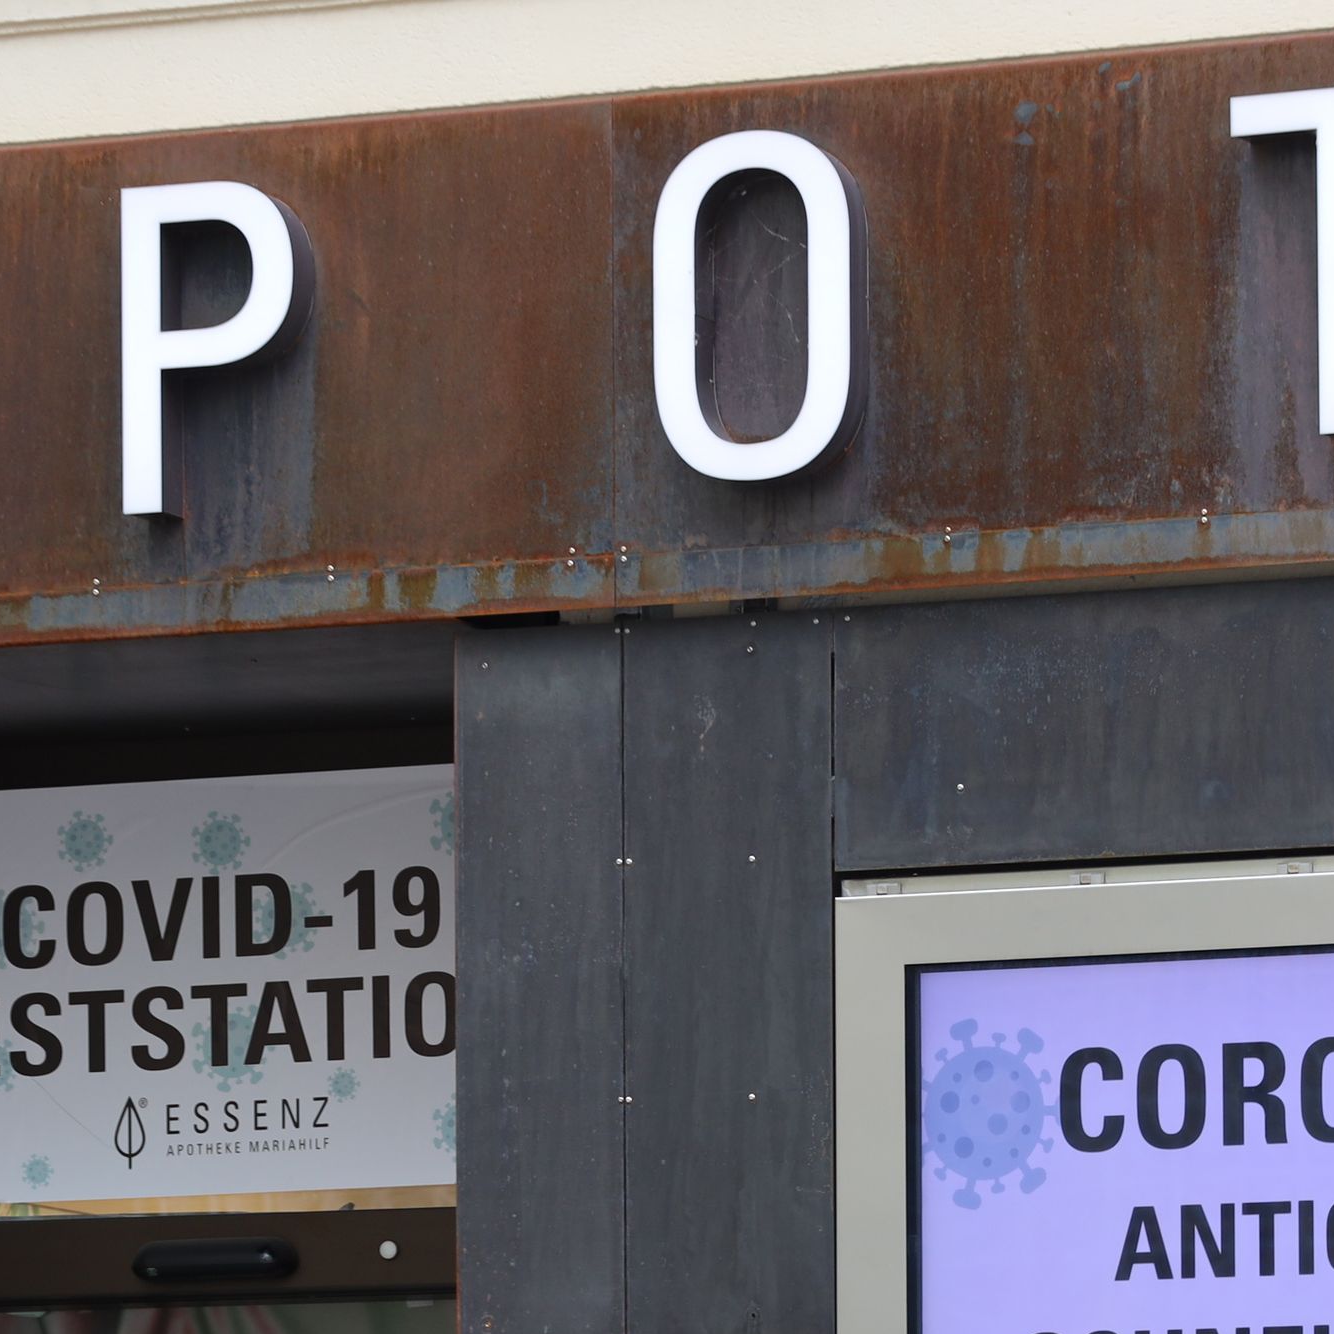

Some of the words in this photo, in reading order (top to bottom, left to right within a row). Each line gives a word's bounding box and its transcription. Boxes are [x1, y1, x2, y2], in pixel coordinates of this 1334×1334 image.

[1, 865, 442, 970] COVID-19
[166, 1096, 329, 1135] ESSENZ
[166, 1141, 241, 1156] APOTHEKE
[249, 1137, 330, 1153] MARIAHILF
